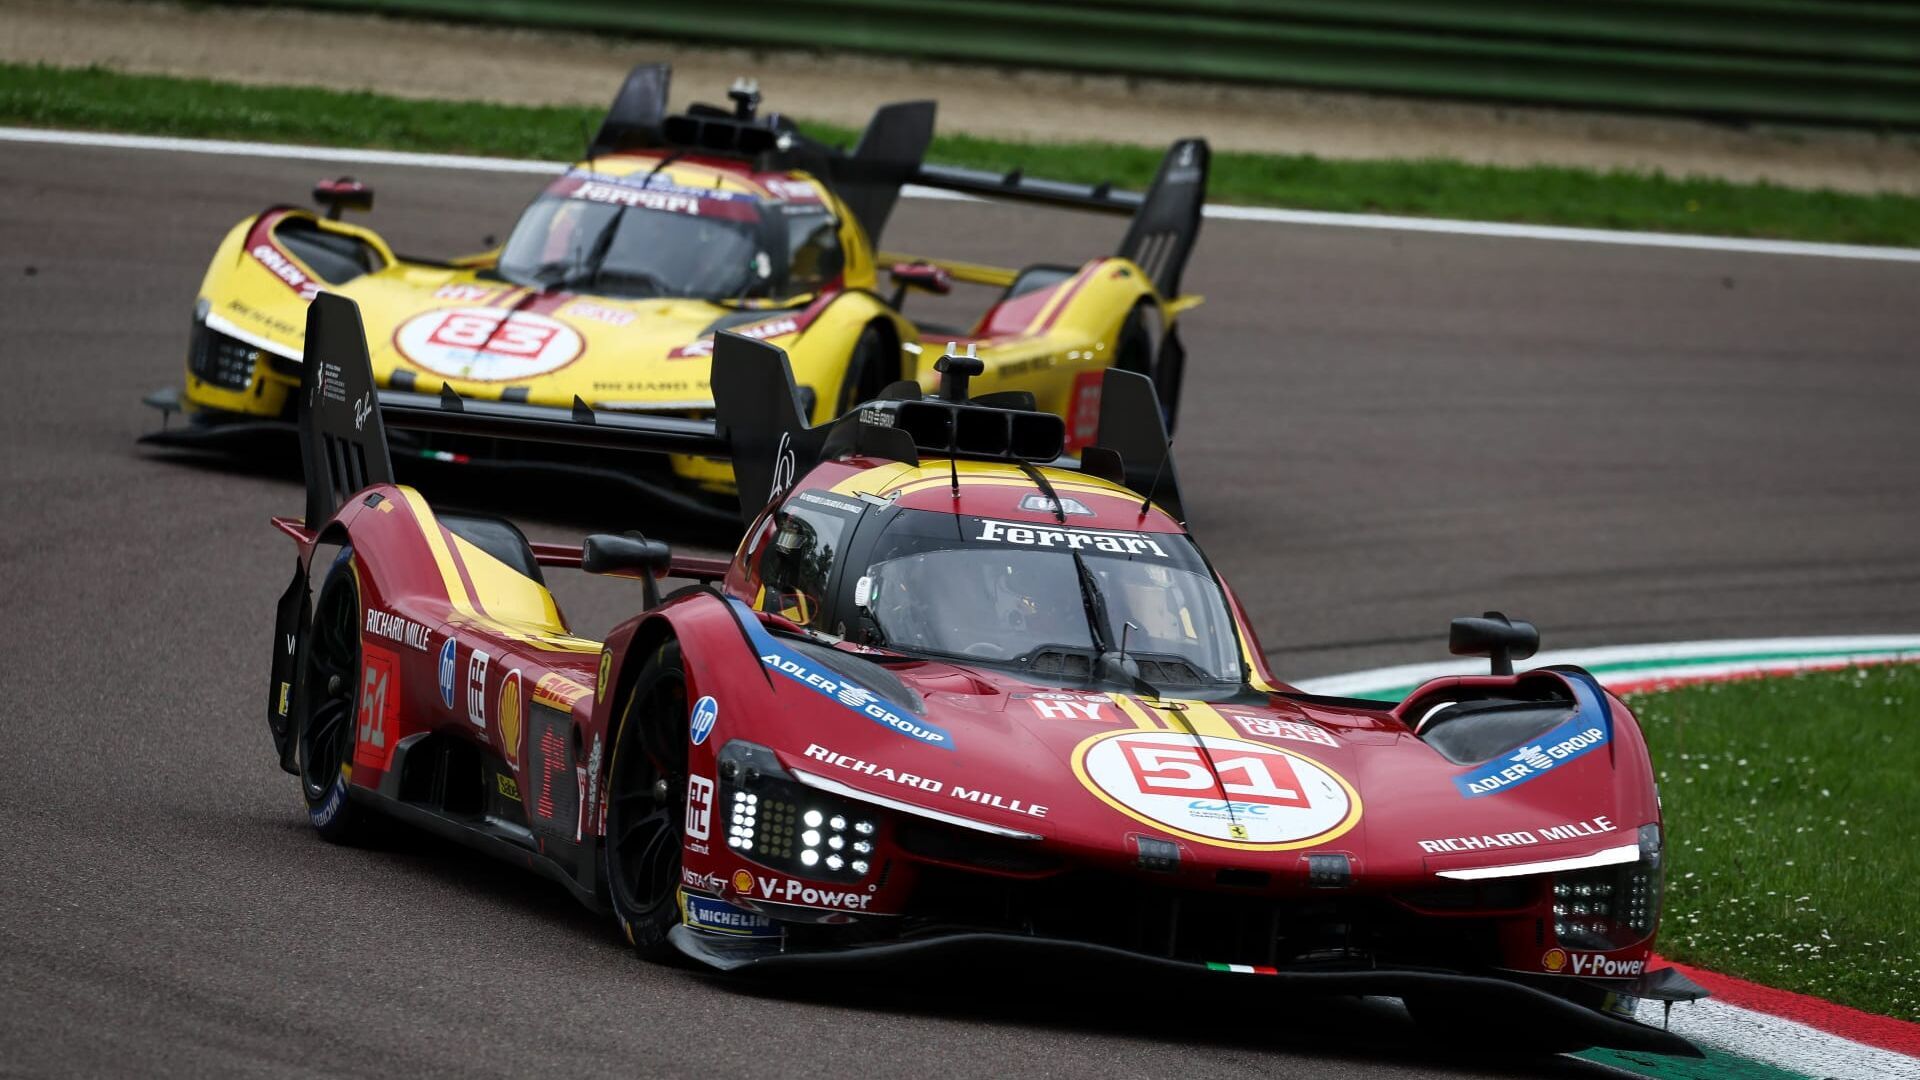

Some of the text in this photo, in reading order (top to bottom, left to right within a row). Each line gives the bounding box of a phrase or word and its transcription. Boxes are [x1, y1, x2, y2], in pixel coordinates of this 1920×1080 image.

[572, 181, 700, 216] Ferrari
[253, 244, 307, 287] ORLEN
[436, 314, 548, 357] 83
[975, 519, 1169, 558] Ferrari
[366, 608, 432, 651] RICHARD MILLE
[359, 666, 388, 748] 51
[760, 653, 945, 743] ADLER GROUP
[1032, 699, 1103, 720] HY
[1248, 723, 1336, 746] CAR
[803, 743, 1049, 818] RICHARD MILLE
[1131, 747, 1300, 800] 51
[1467, 727, 1605, 794] ADLER GROUP
[1417, 816, 1617, 854] RICHARD MILLE
[758, 876, 873, 909] V-Power
[699, 907, 771, 928] MICHELIN
[1571, 953, 1644, 976] V-Power
